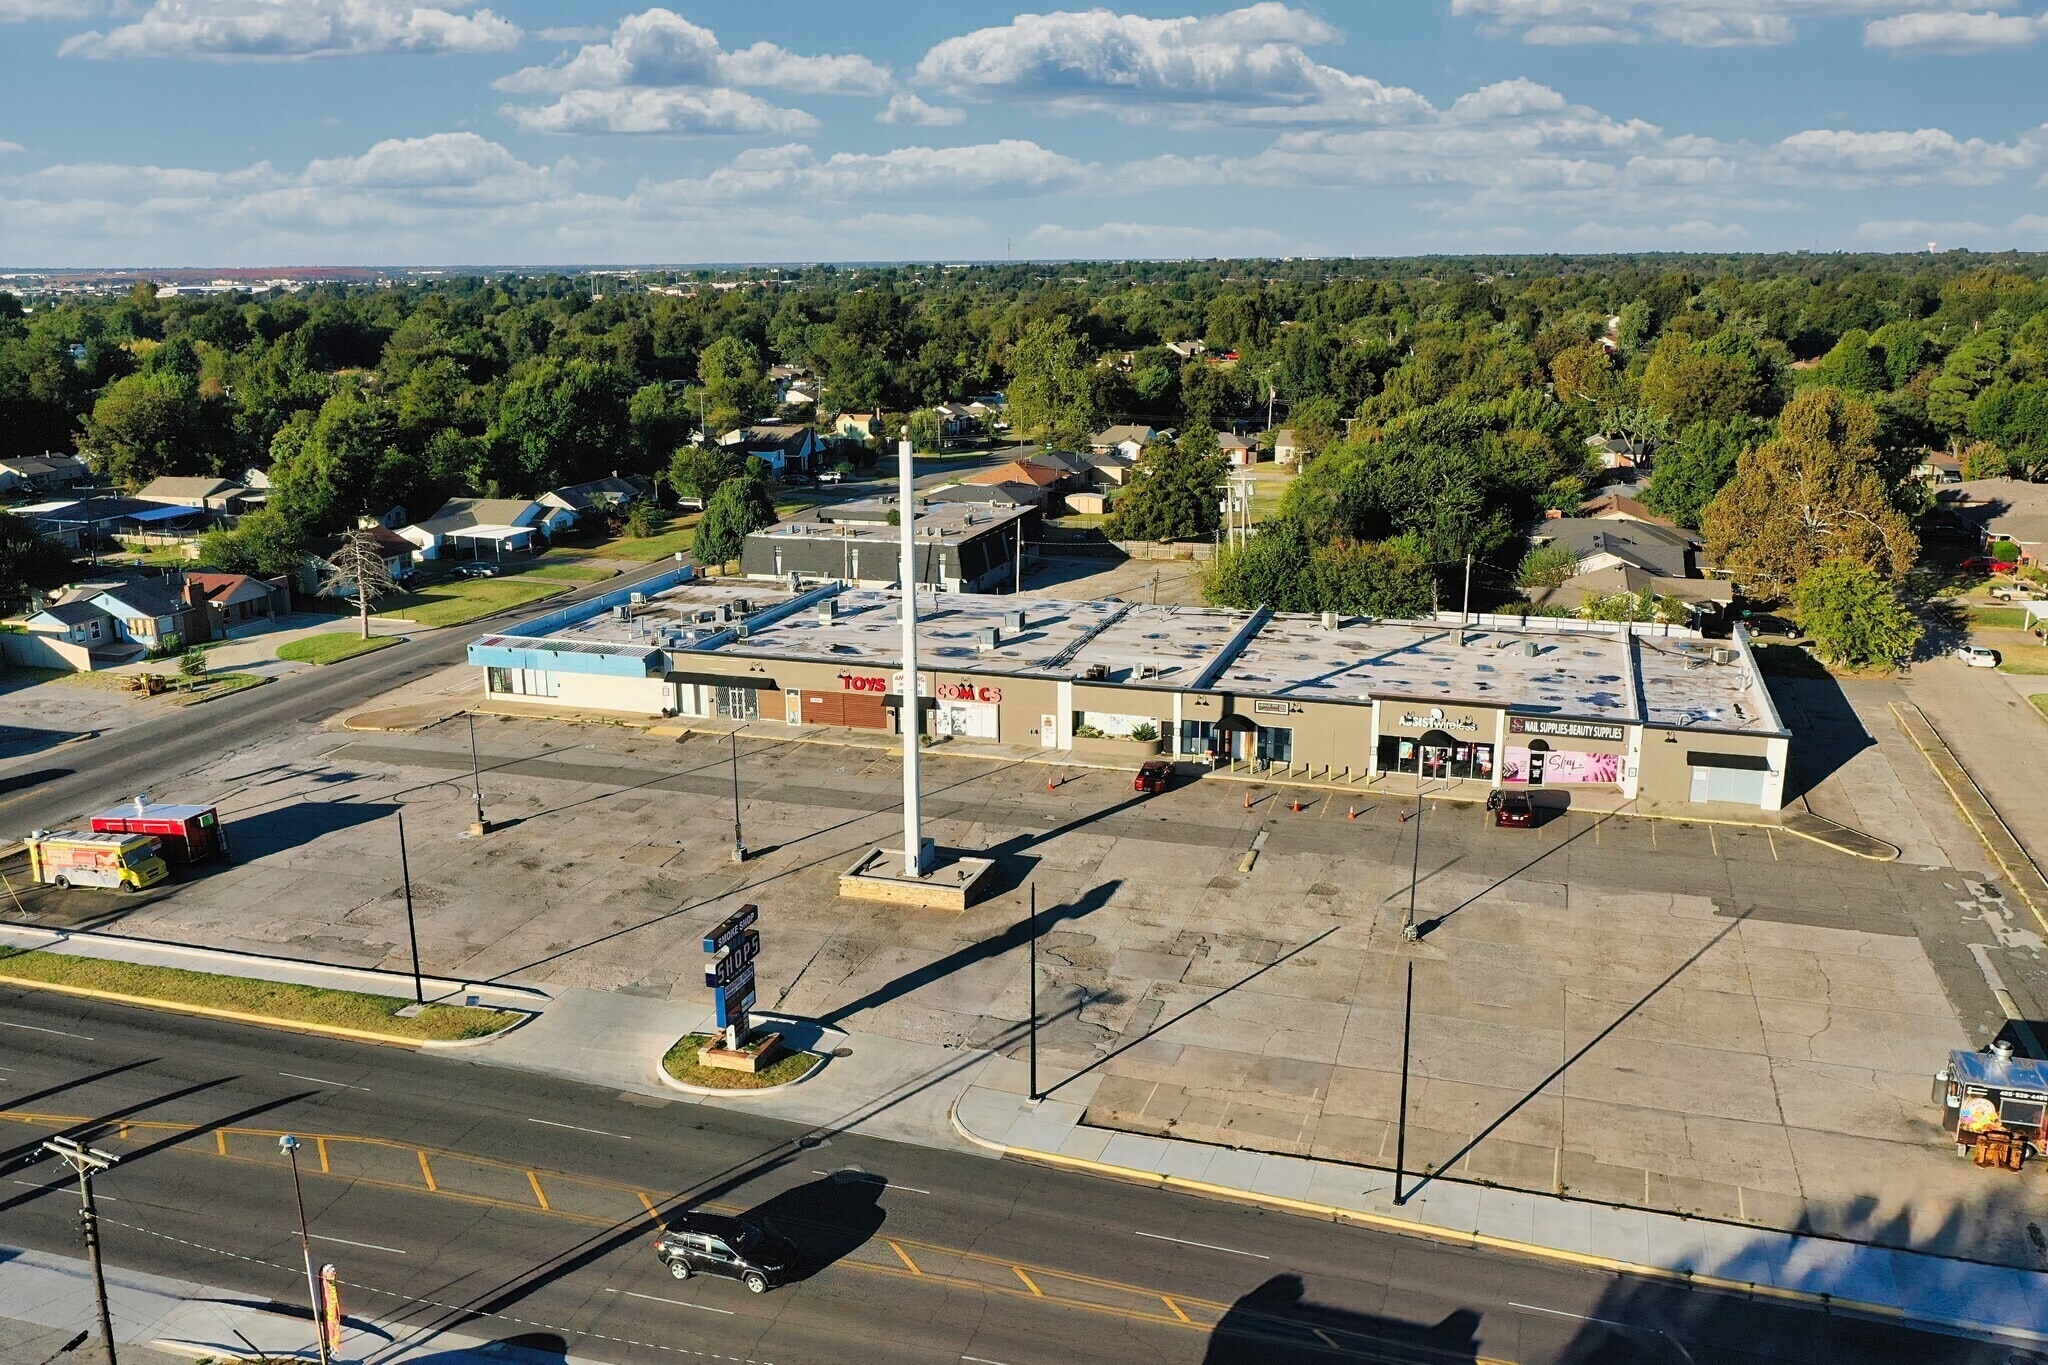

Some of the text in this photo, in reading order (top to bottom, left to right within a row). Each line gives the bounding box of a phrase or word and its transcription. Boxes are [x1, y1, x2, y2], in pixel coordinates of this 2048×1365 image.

[842, 676, 886, 692] TOYS
[938, 684, 1002, 702] COMICS
[1525, 721, 1539, 732] NAIL
[1593, 726, 1622, 739] SUPPLIES
[718, 912, 755, 948] SMOKE SHOP
[717, 935, 759, 984] SHOPS
